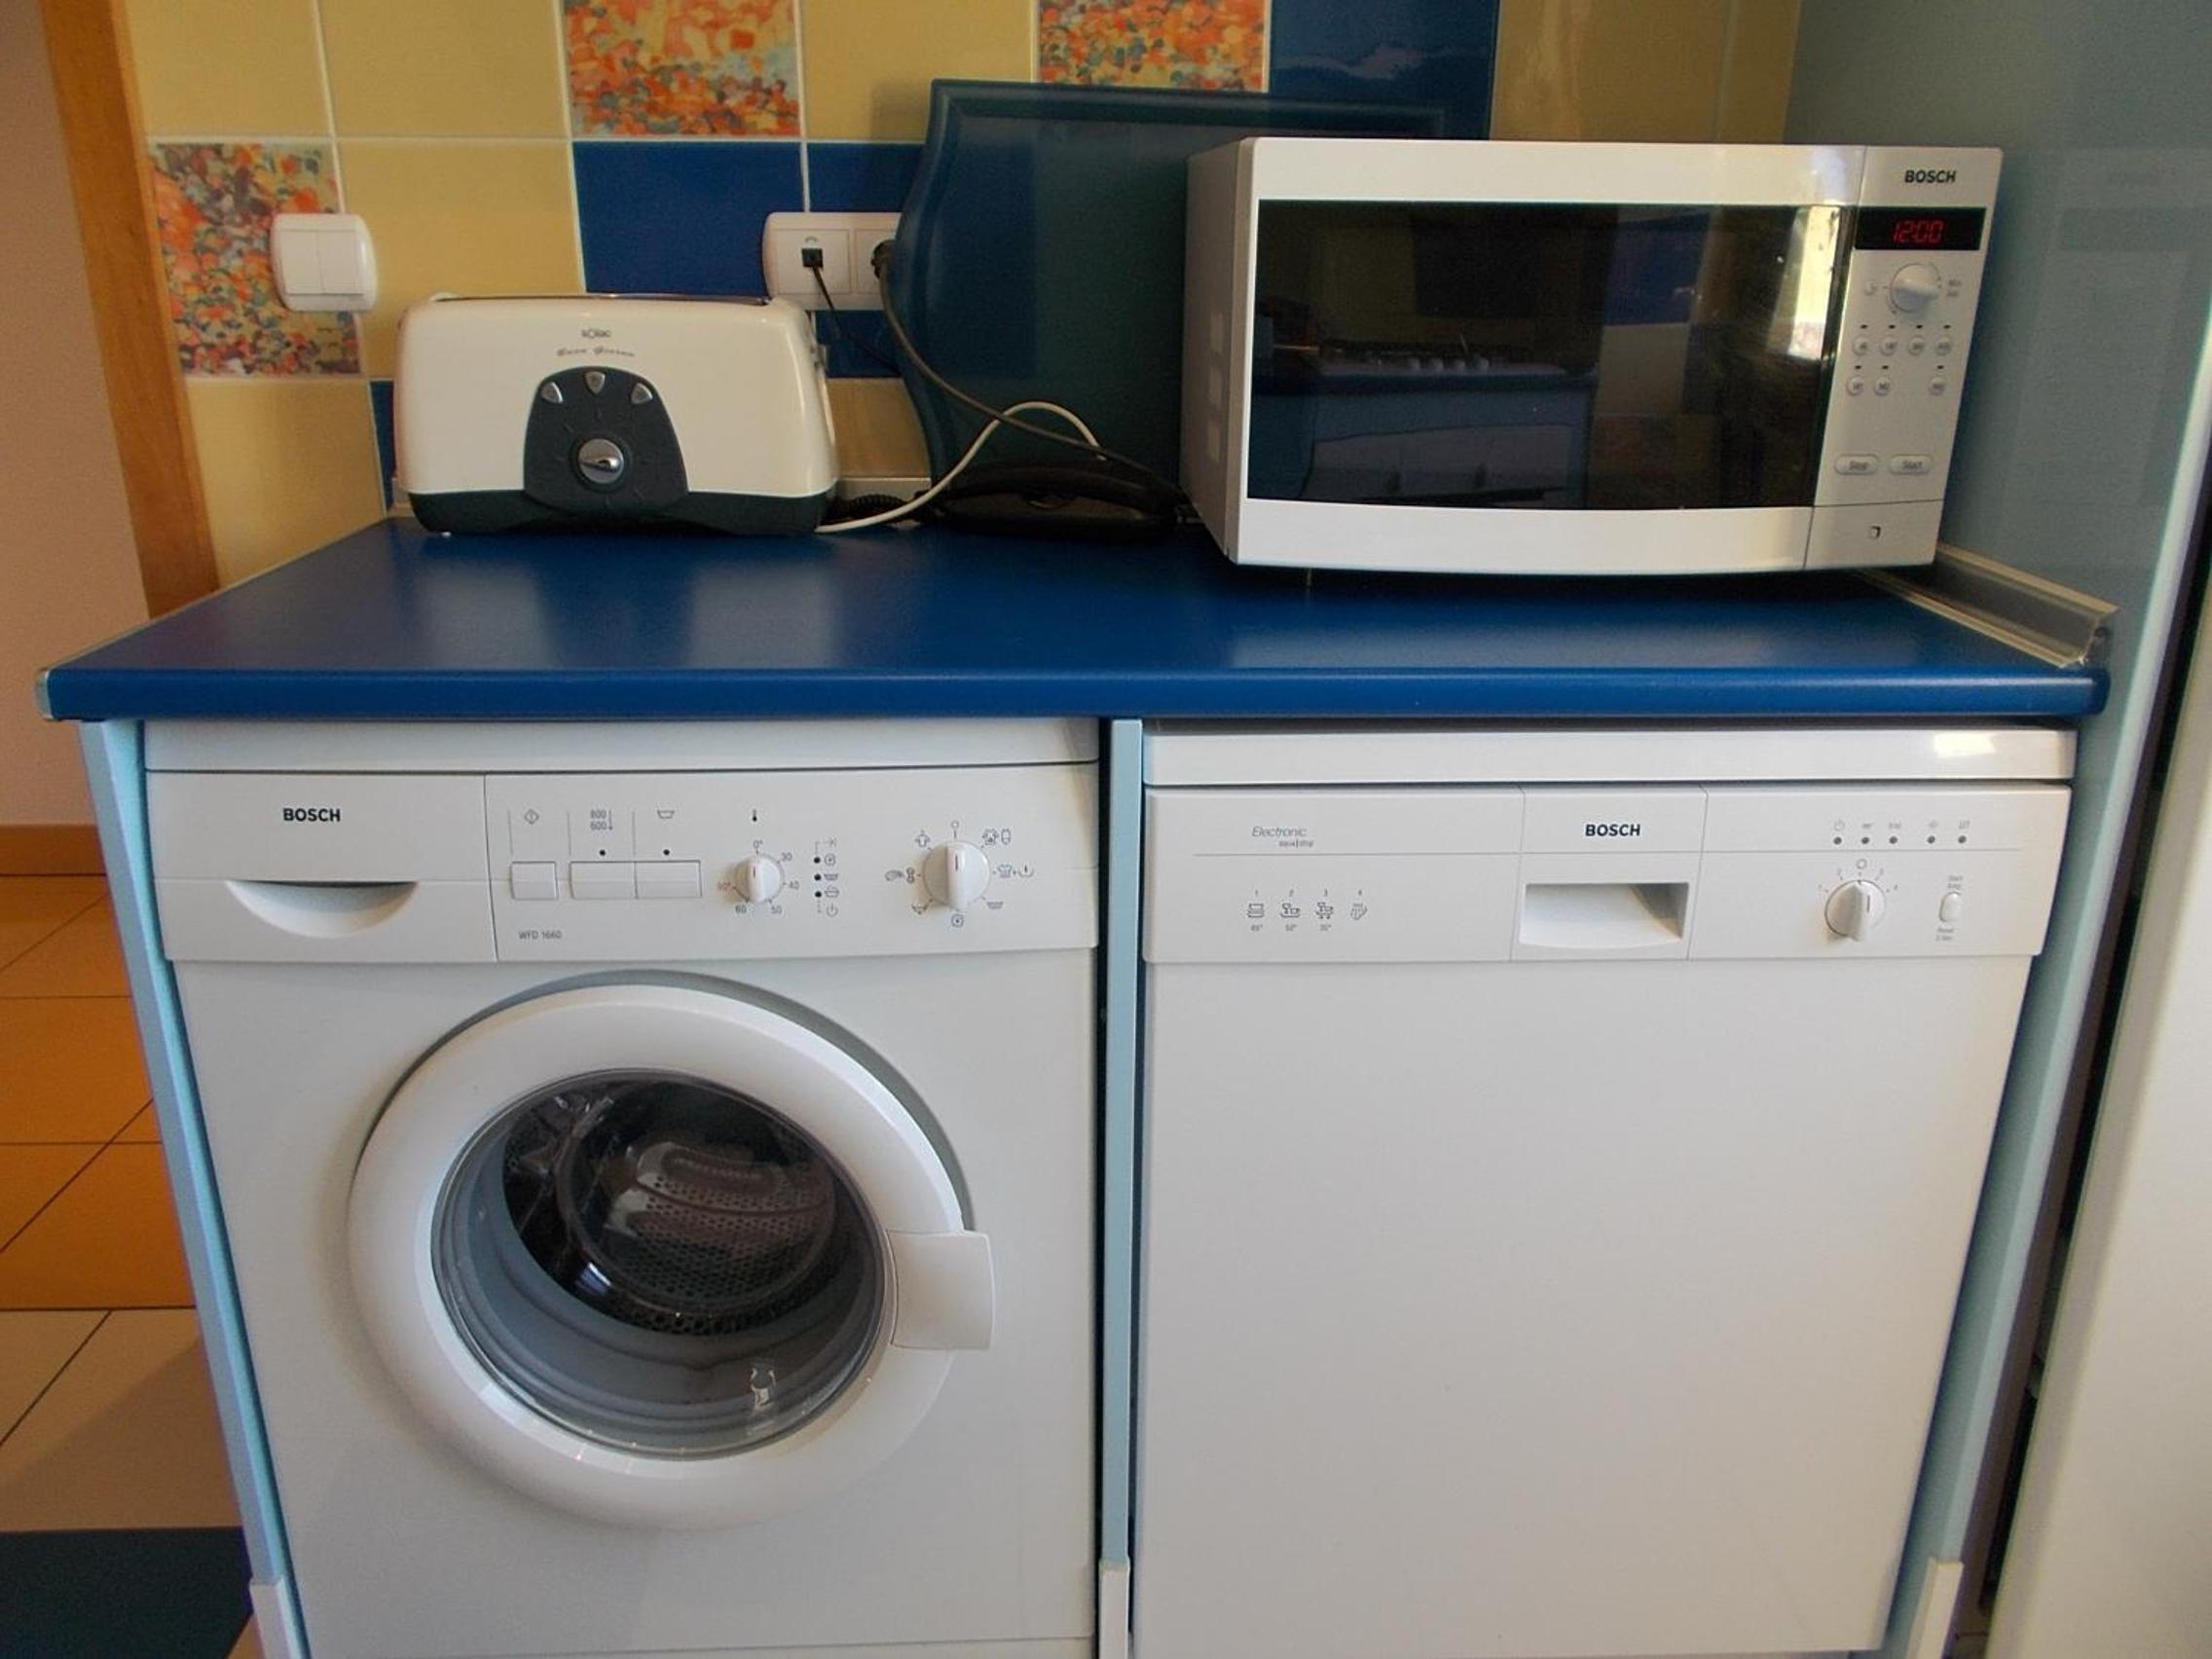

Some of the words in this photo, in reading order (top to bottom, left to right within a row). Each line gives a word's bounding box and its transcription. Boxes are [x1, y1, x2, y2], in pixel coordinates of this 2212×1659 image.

[1904, 169, 1957, 183] BOSCH
[282, 808, 341, 822] BOSCH
[1252, 825, 1308, 837] Electronic
[1585, 824, 1641, 836] BOSCH
